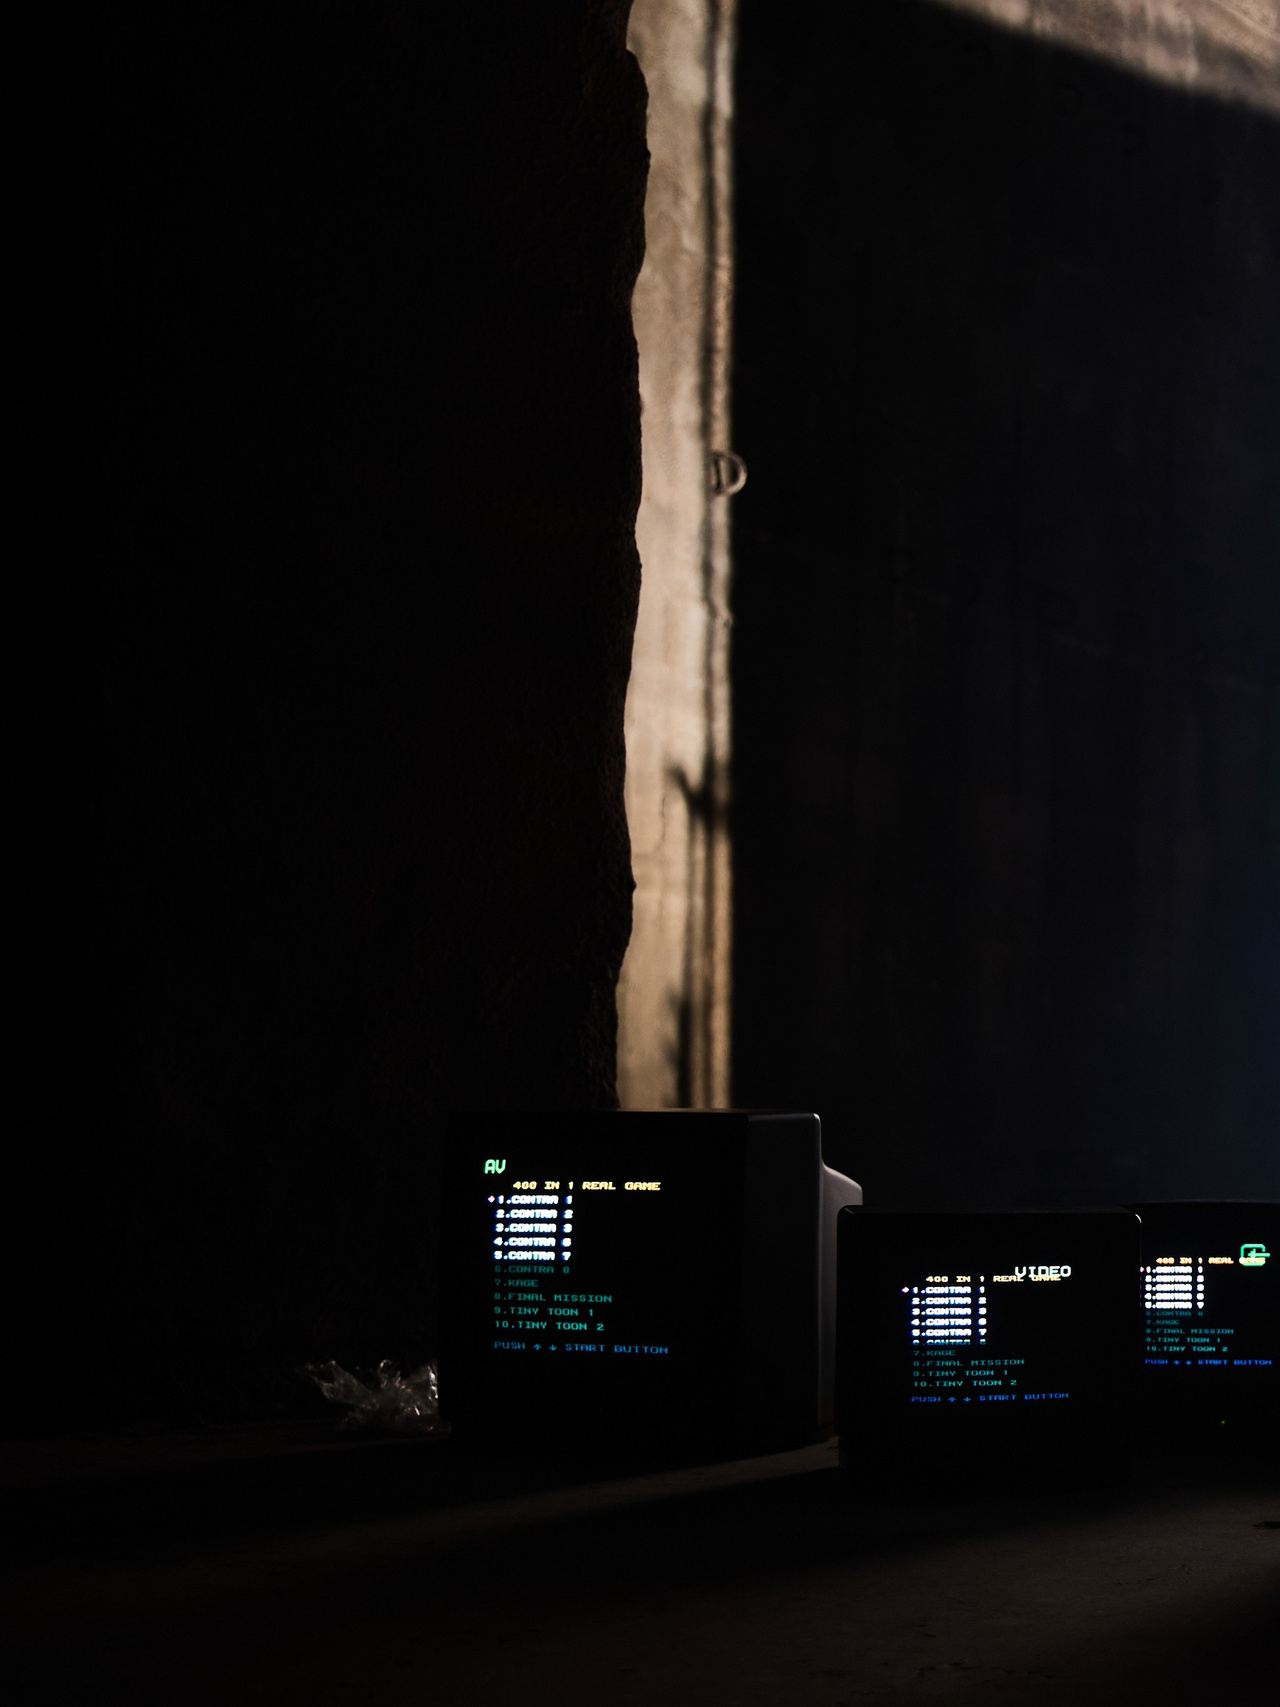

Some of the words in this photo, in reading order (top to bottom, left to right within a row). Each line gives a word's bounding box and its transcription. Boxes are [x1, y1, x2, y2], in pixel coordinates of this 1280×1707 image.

[484, 1159, 506, 1174] AV
[513, 1181, 537, 1189] 400
[544, 1181, 560, 1190] IN
[569, 1181, 573, 1189] 1
[582, 1182, 616, 1190] REAL
[625, 1182, 661, 1190] GAME
[497, 1195, 559, 1204] 1.CONTRA
[565, 1196, 572, 1204] 1
[495, 1209, 557, 1219] 2.CONTRA
[563, 1210, 573, 1219] 2
[495, 1223, 556, 1233] 3.CONTRA
[562, 1224, 572, 1233] 3
[493, 1237, 556, 1246] 4.CONTRA
[493, 1251, 555, 1260] 5.CONTRA
[561, 1252, 571, 1260] 7
[495, 1279, 538, 1287] 7.KAGE
[495, 1293, 546, 1301] 8.FINAL
[554, 1294, 612, 1302] MISSION
[495, 1307, 539, 1315] 9.TINY
[548, 1308, 578, 1316] TOON
[496, 1321, 547, 1329] 10.TINY
[556, 1322, 587, 1330] TOON
[597, 1323, 604, 1331] 2
[566, 1344, 604, 1352] START
[614, 1345, 668, 1354] BUTTON
